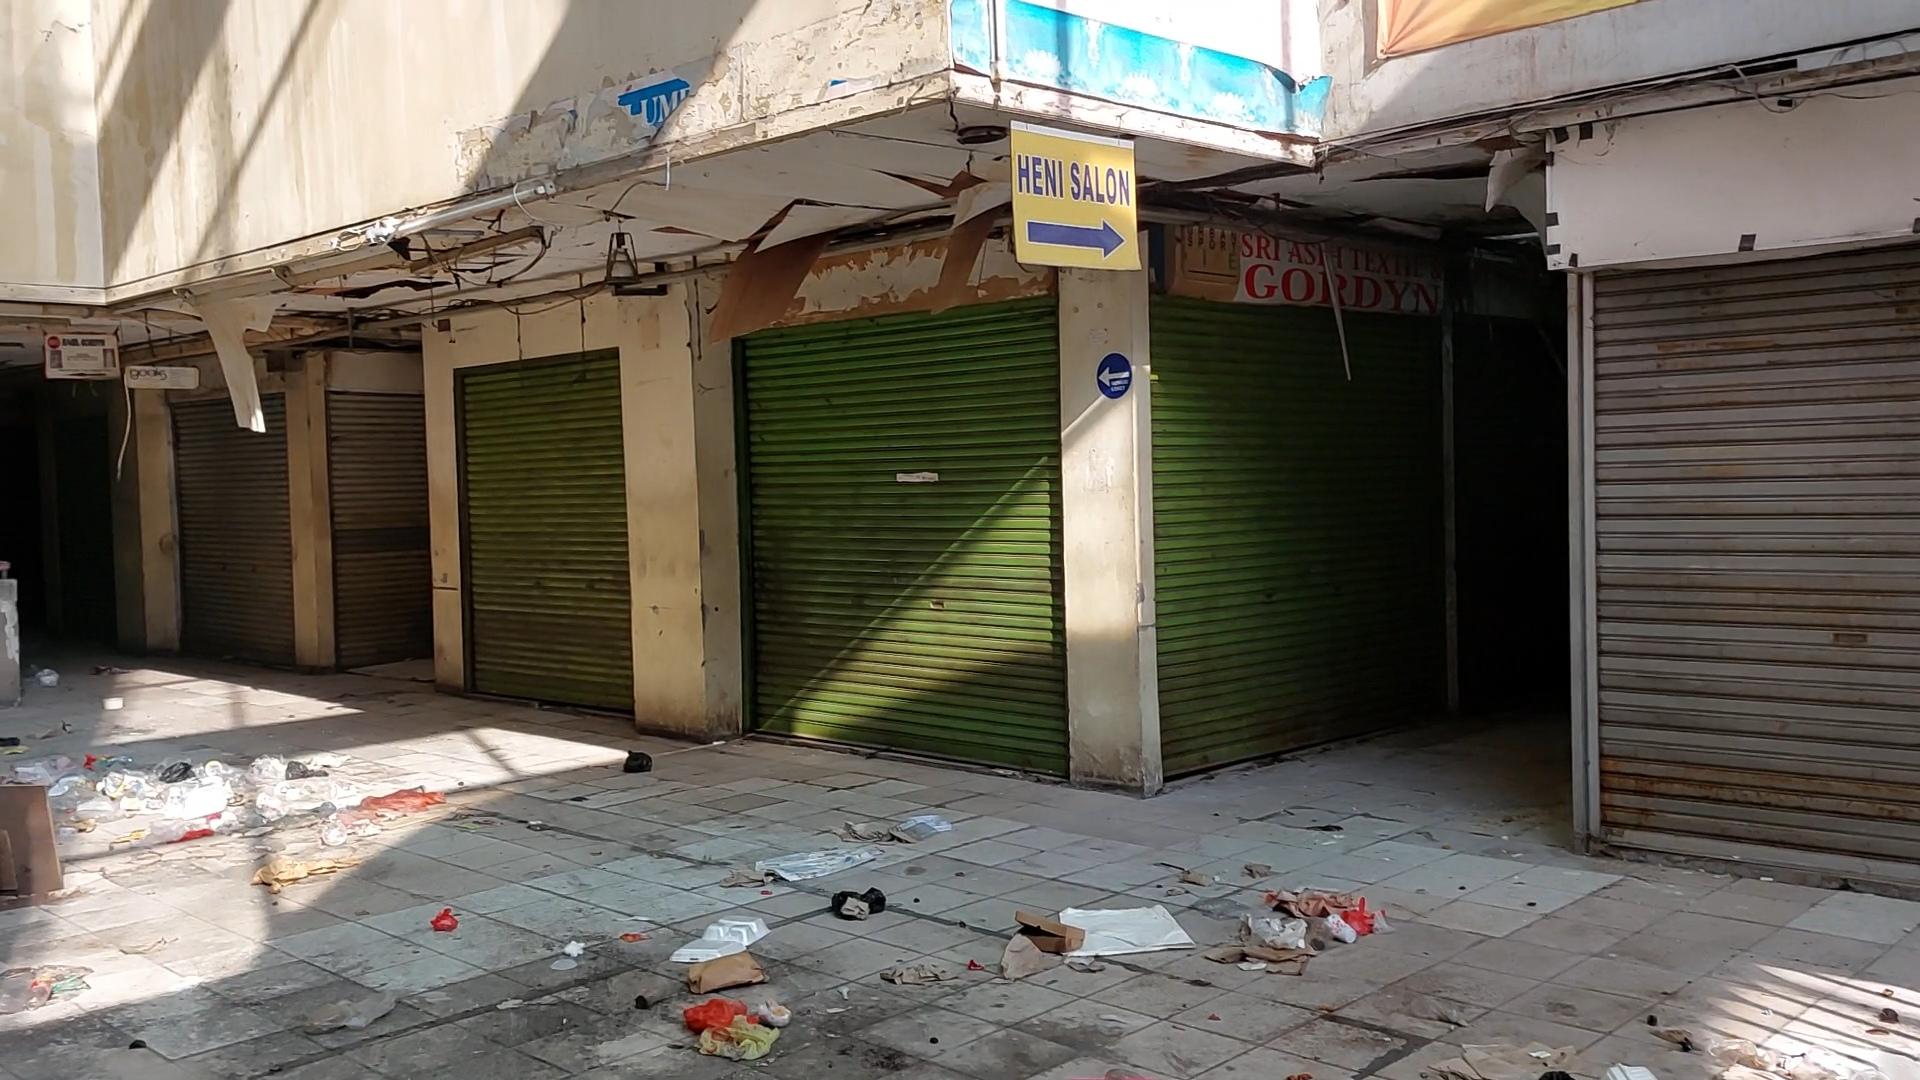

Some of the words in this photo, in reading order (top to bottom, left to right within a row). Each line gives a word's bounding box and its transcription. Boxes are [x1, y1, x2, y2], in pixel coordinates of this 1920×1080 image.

[1017, 154, 1064, 198] HENI
[1070, 162, 1130, 206] SALON
[1241, 233, 1280, 261] SRI
[1245, 264, 1441, 314] GORDYN
